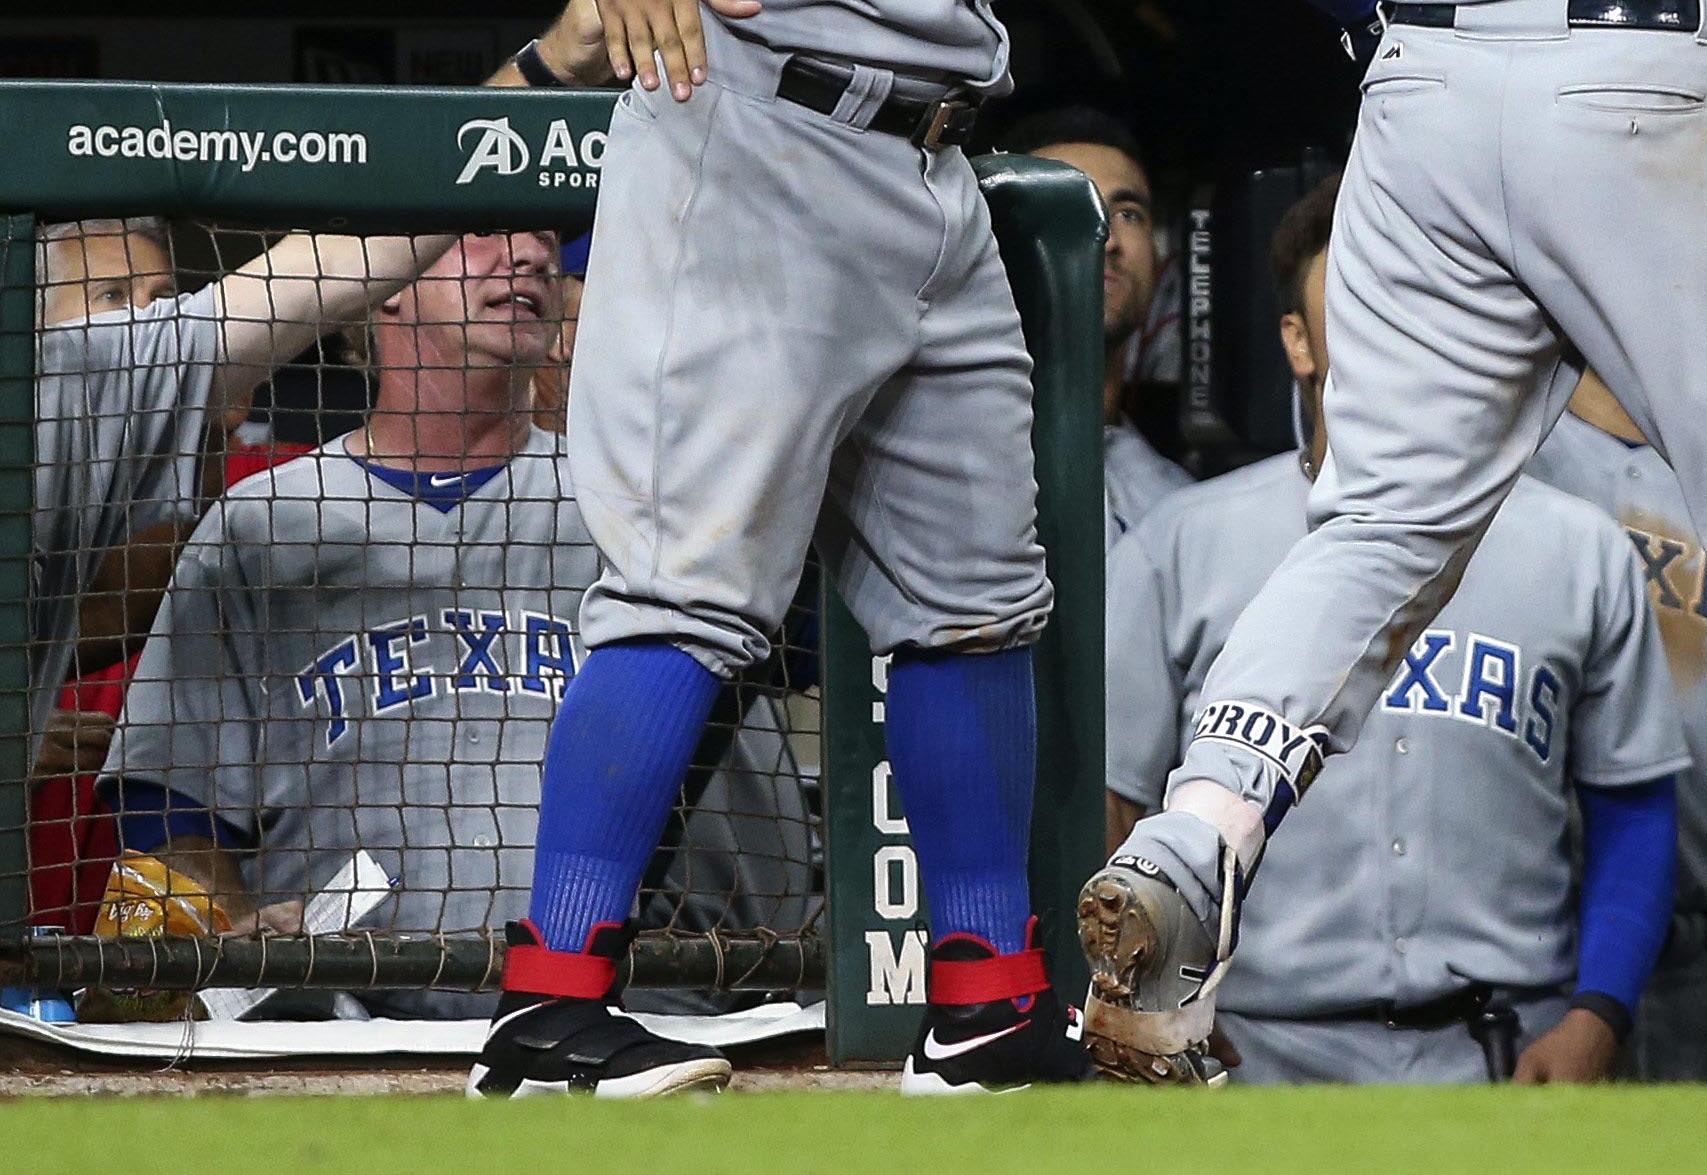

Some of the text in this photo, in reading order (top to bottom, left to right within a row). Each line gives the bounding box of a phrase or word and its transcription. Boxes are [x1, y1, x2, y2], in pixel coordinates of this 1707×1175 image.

[68, 119, 367, 172] academy.com
[539, 118, 609, 168] Ac
[538, 171, 598, 188] SPOR
[294, 607, 584, 750] TEXA
[1381, 628, 1561, 768] XAS
